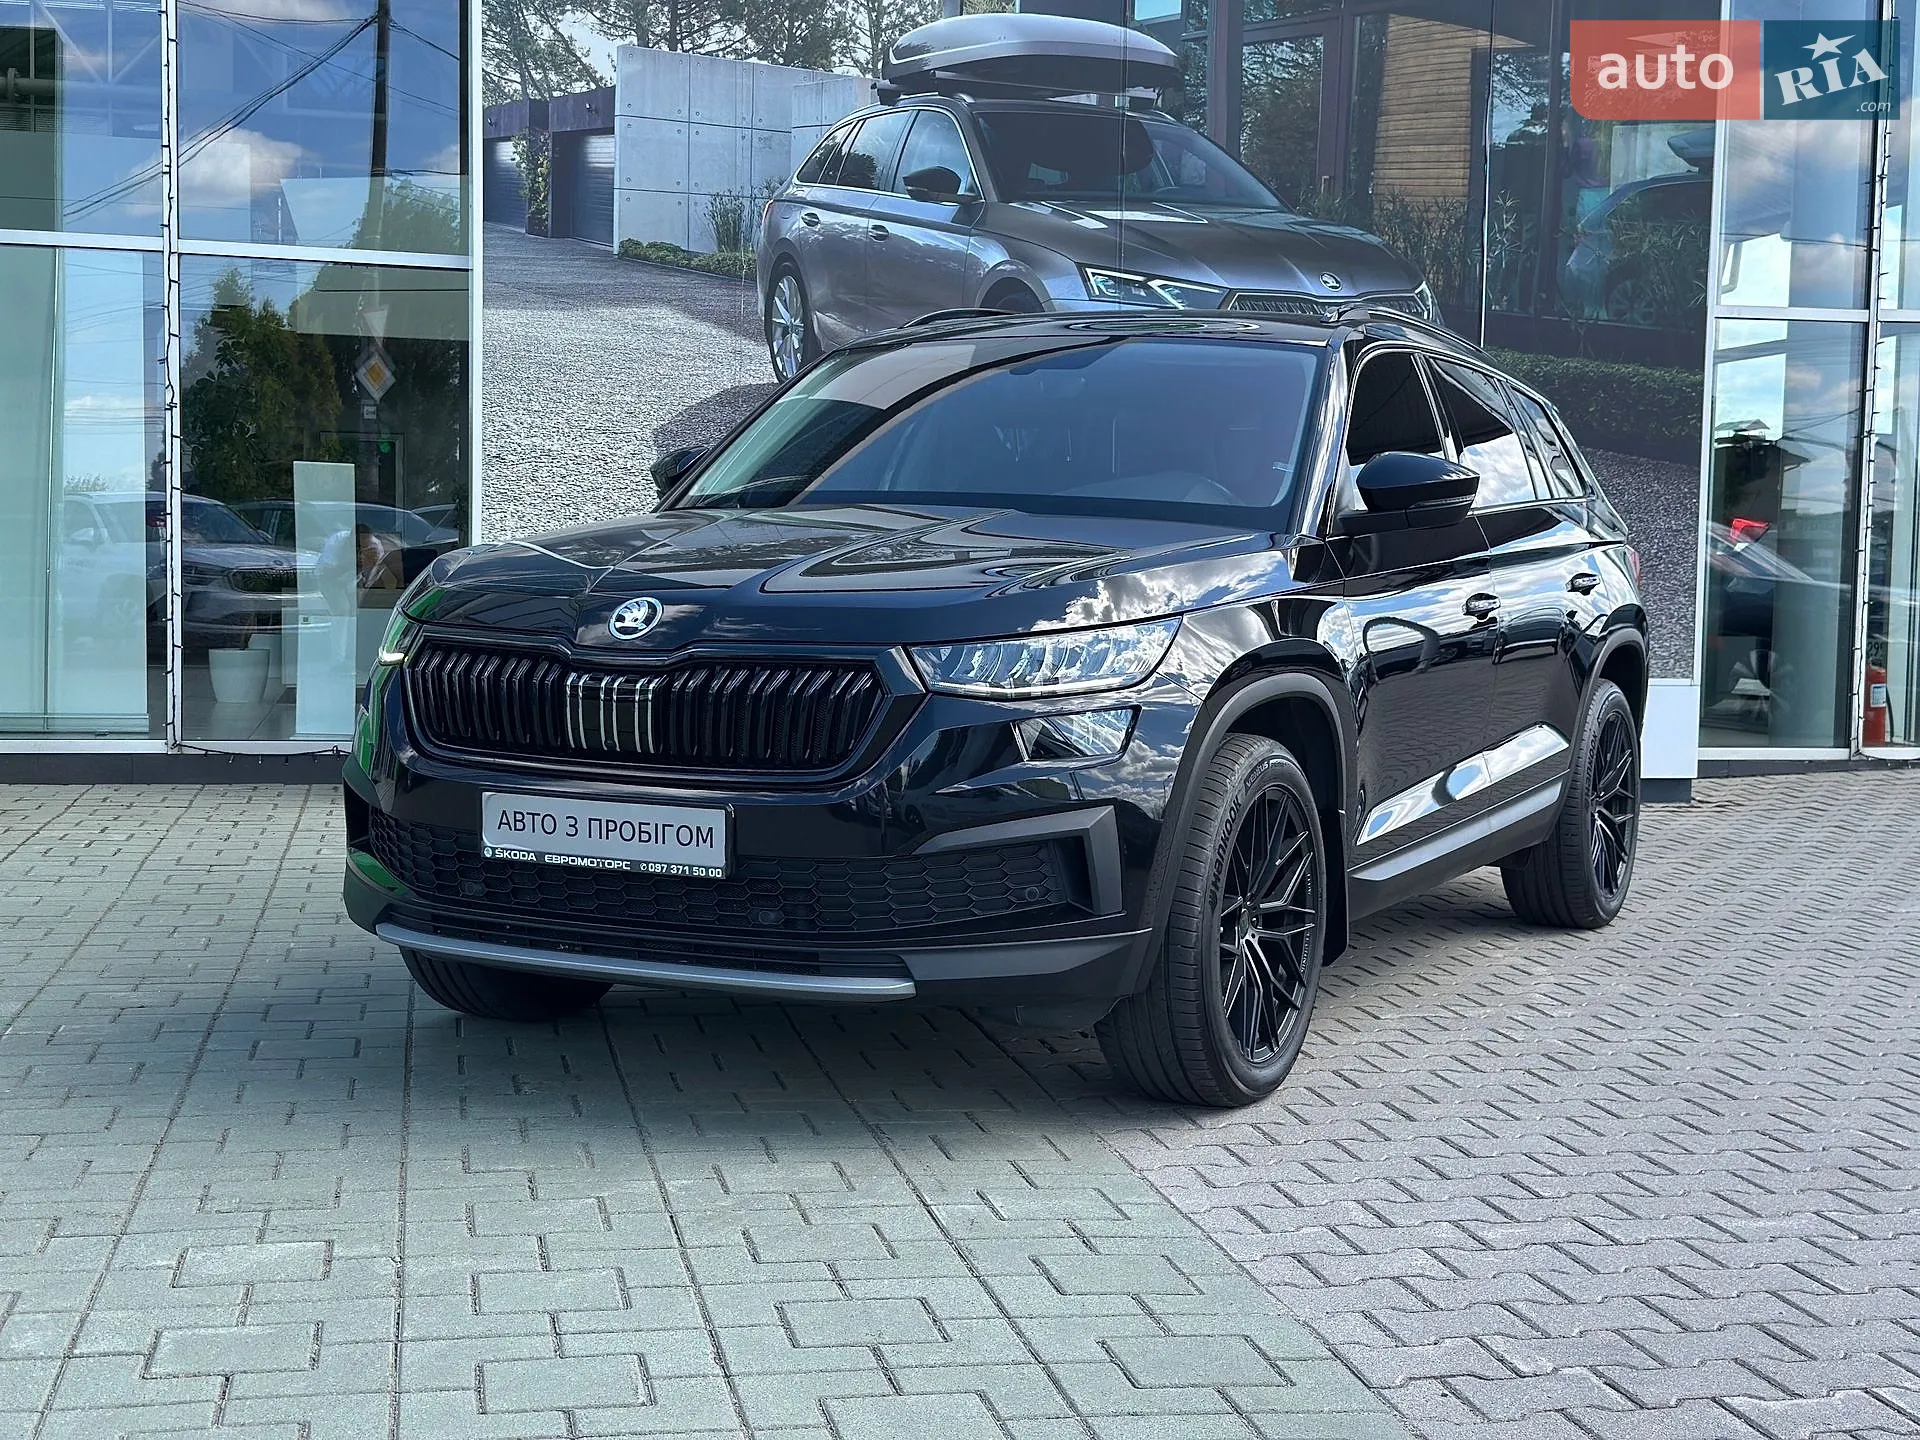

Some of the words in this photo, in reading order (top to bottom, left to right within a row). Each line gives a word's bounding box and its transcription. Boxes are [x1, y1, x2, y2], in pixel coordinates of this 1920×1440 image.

[497, 809, 557, 835] АВТО
[565, 815, 578, 837] З
[587, 817, 714, 849] ПРОБІГОМ
[544, 854, 631, 870] ЄВРОМОТОРС
[648, 863, 668, 873] 097
[670, 865, 689, 875] 371
[692, 867, 706, 877] 50
[709, 868, 722, 878] 00
